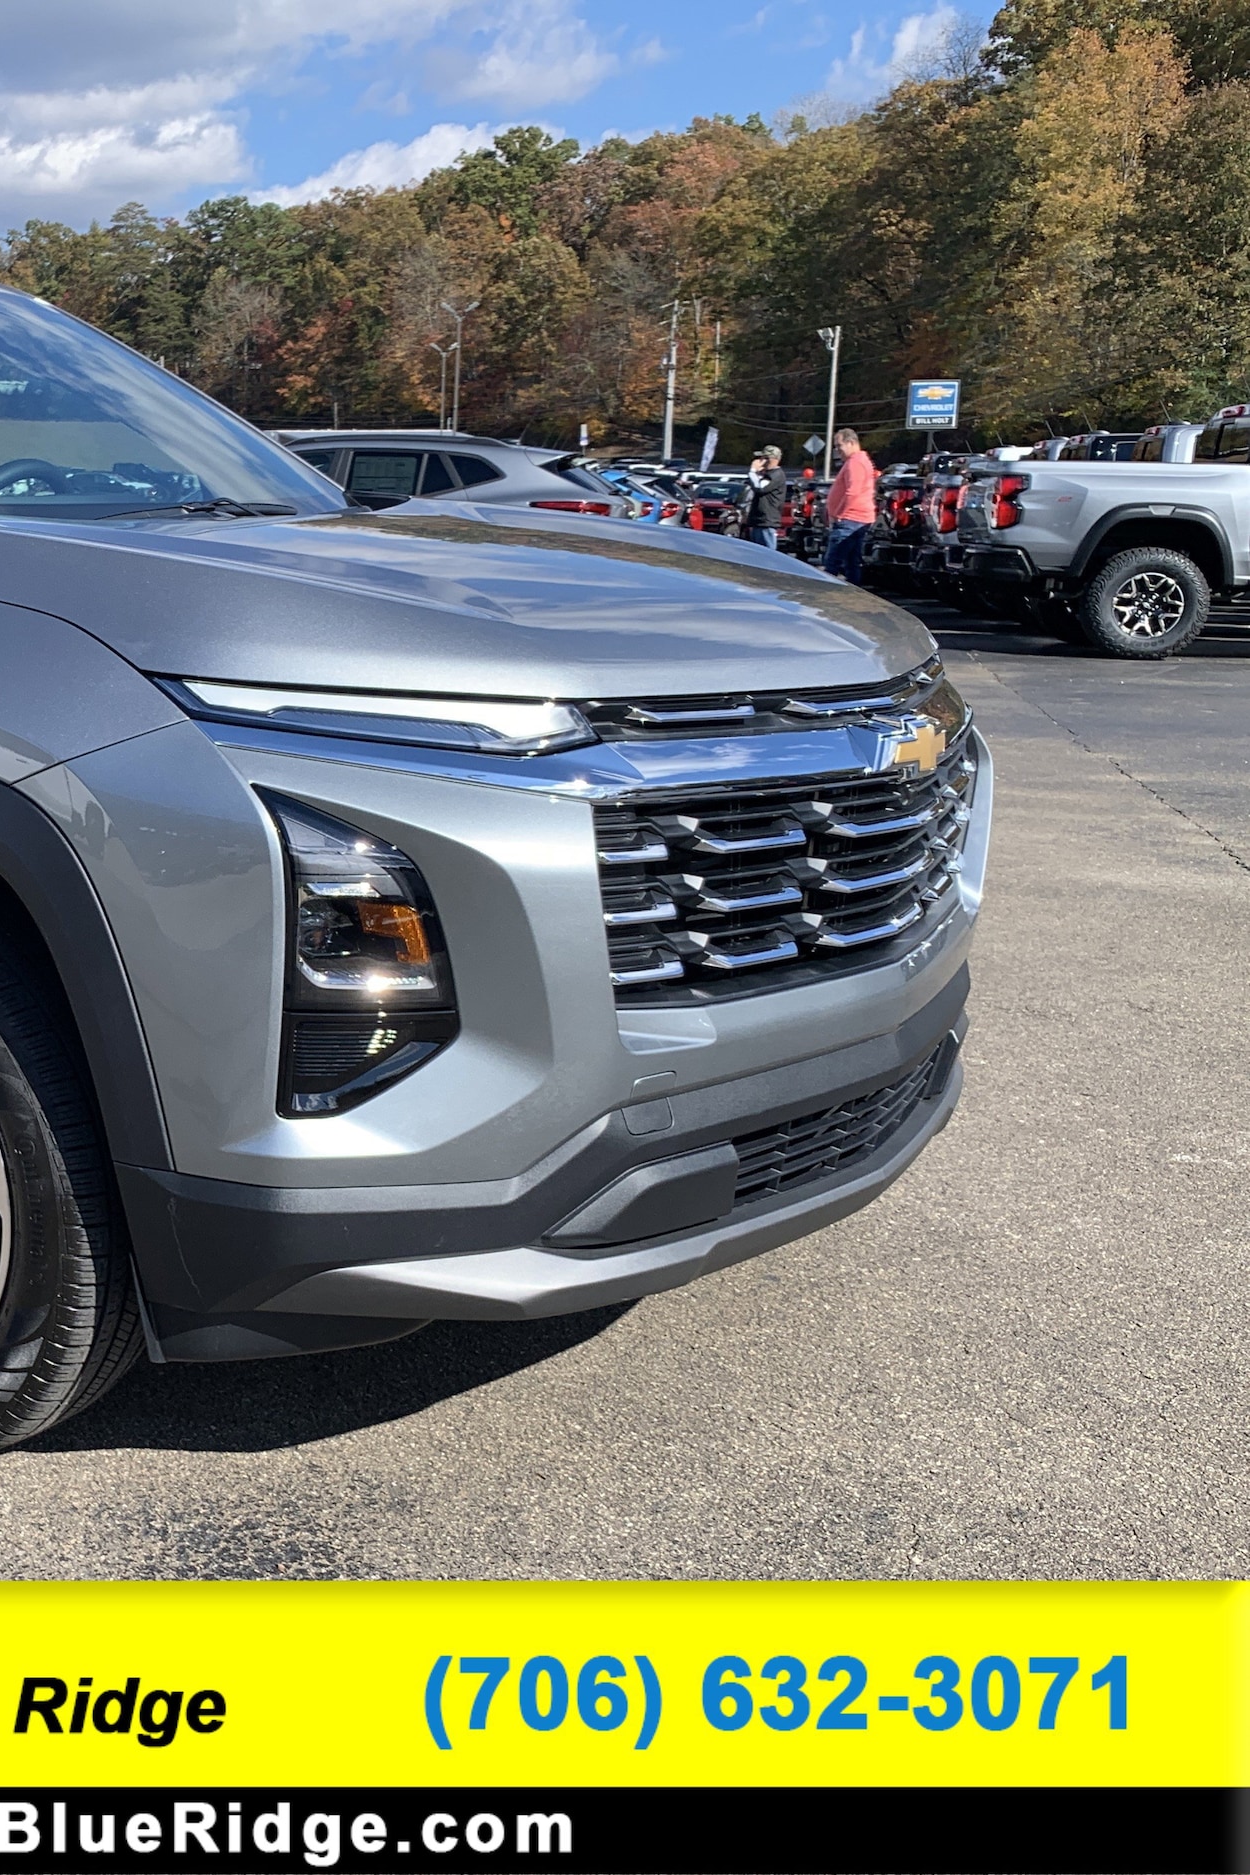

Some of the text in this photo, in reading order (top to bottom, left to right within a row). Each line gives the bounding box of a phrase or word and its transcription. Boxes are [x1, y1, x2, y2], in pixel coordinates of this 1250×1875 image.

[913, 403, 954, 412] CHEVROLET
[915, 416, 950, 425] BILL HOLT
